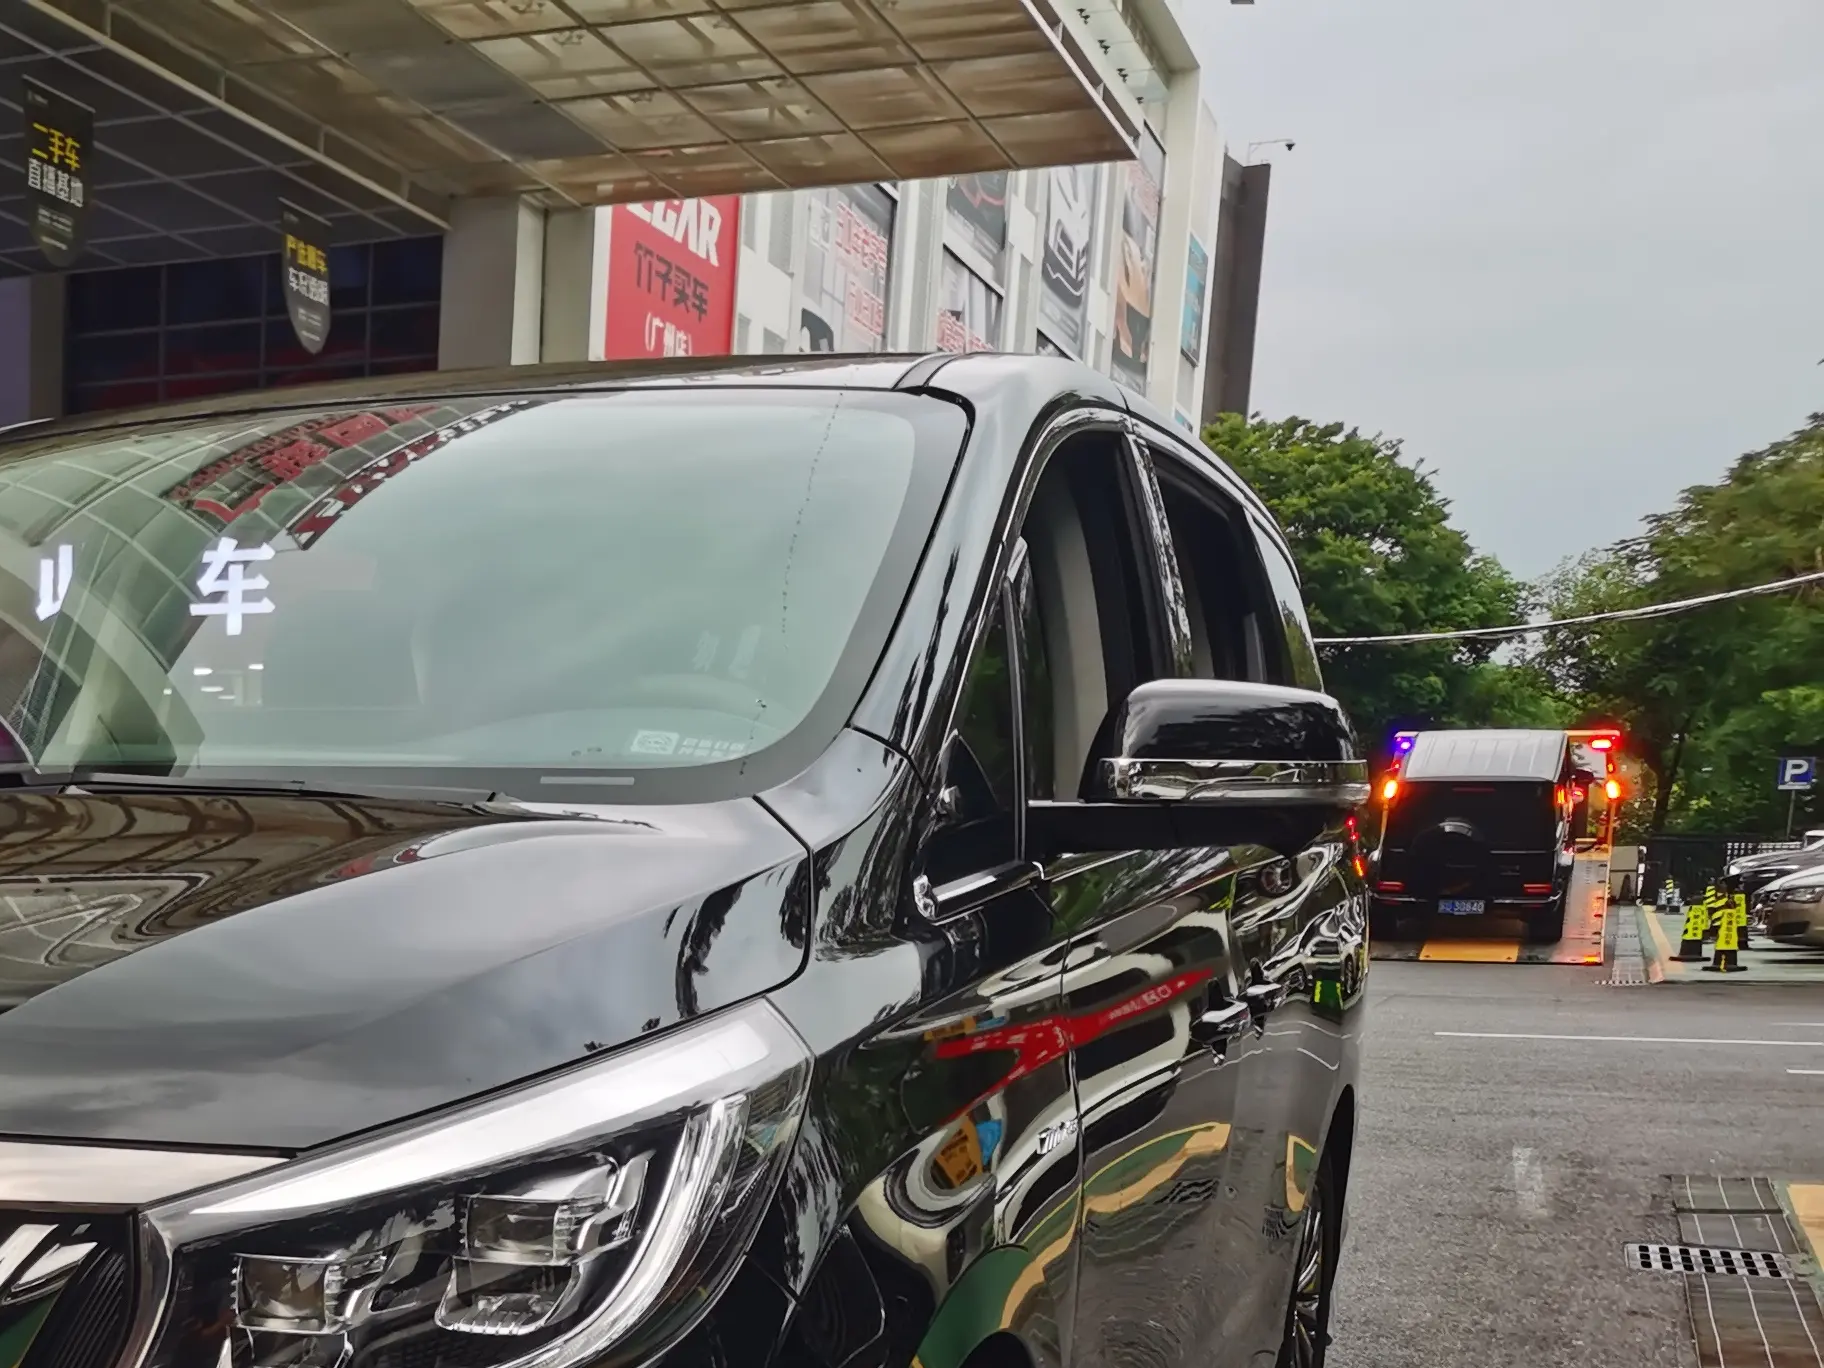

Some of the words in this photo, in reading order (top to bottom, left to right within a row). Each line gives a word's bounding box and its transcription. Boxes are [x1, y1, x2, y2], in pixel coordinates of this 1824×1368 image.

[32, 122, 81, 172] 二手车
[634, 241, 709, 323] 竹子买车
[1784, 759, 1809, 782] P
